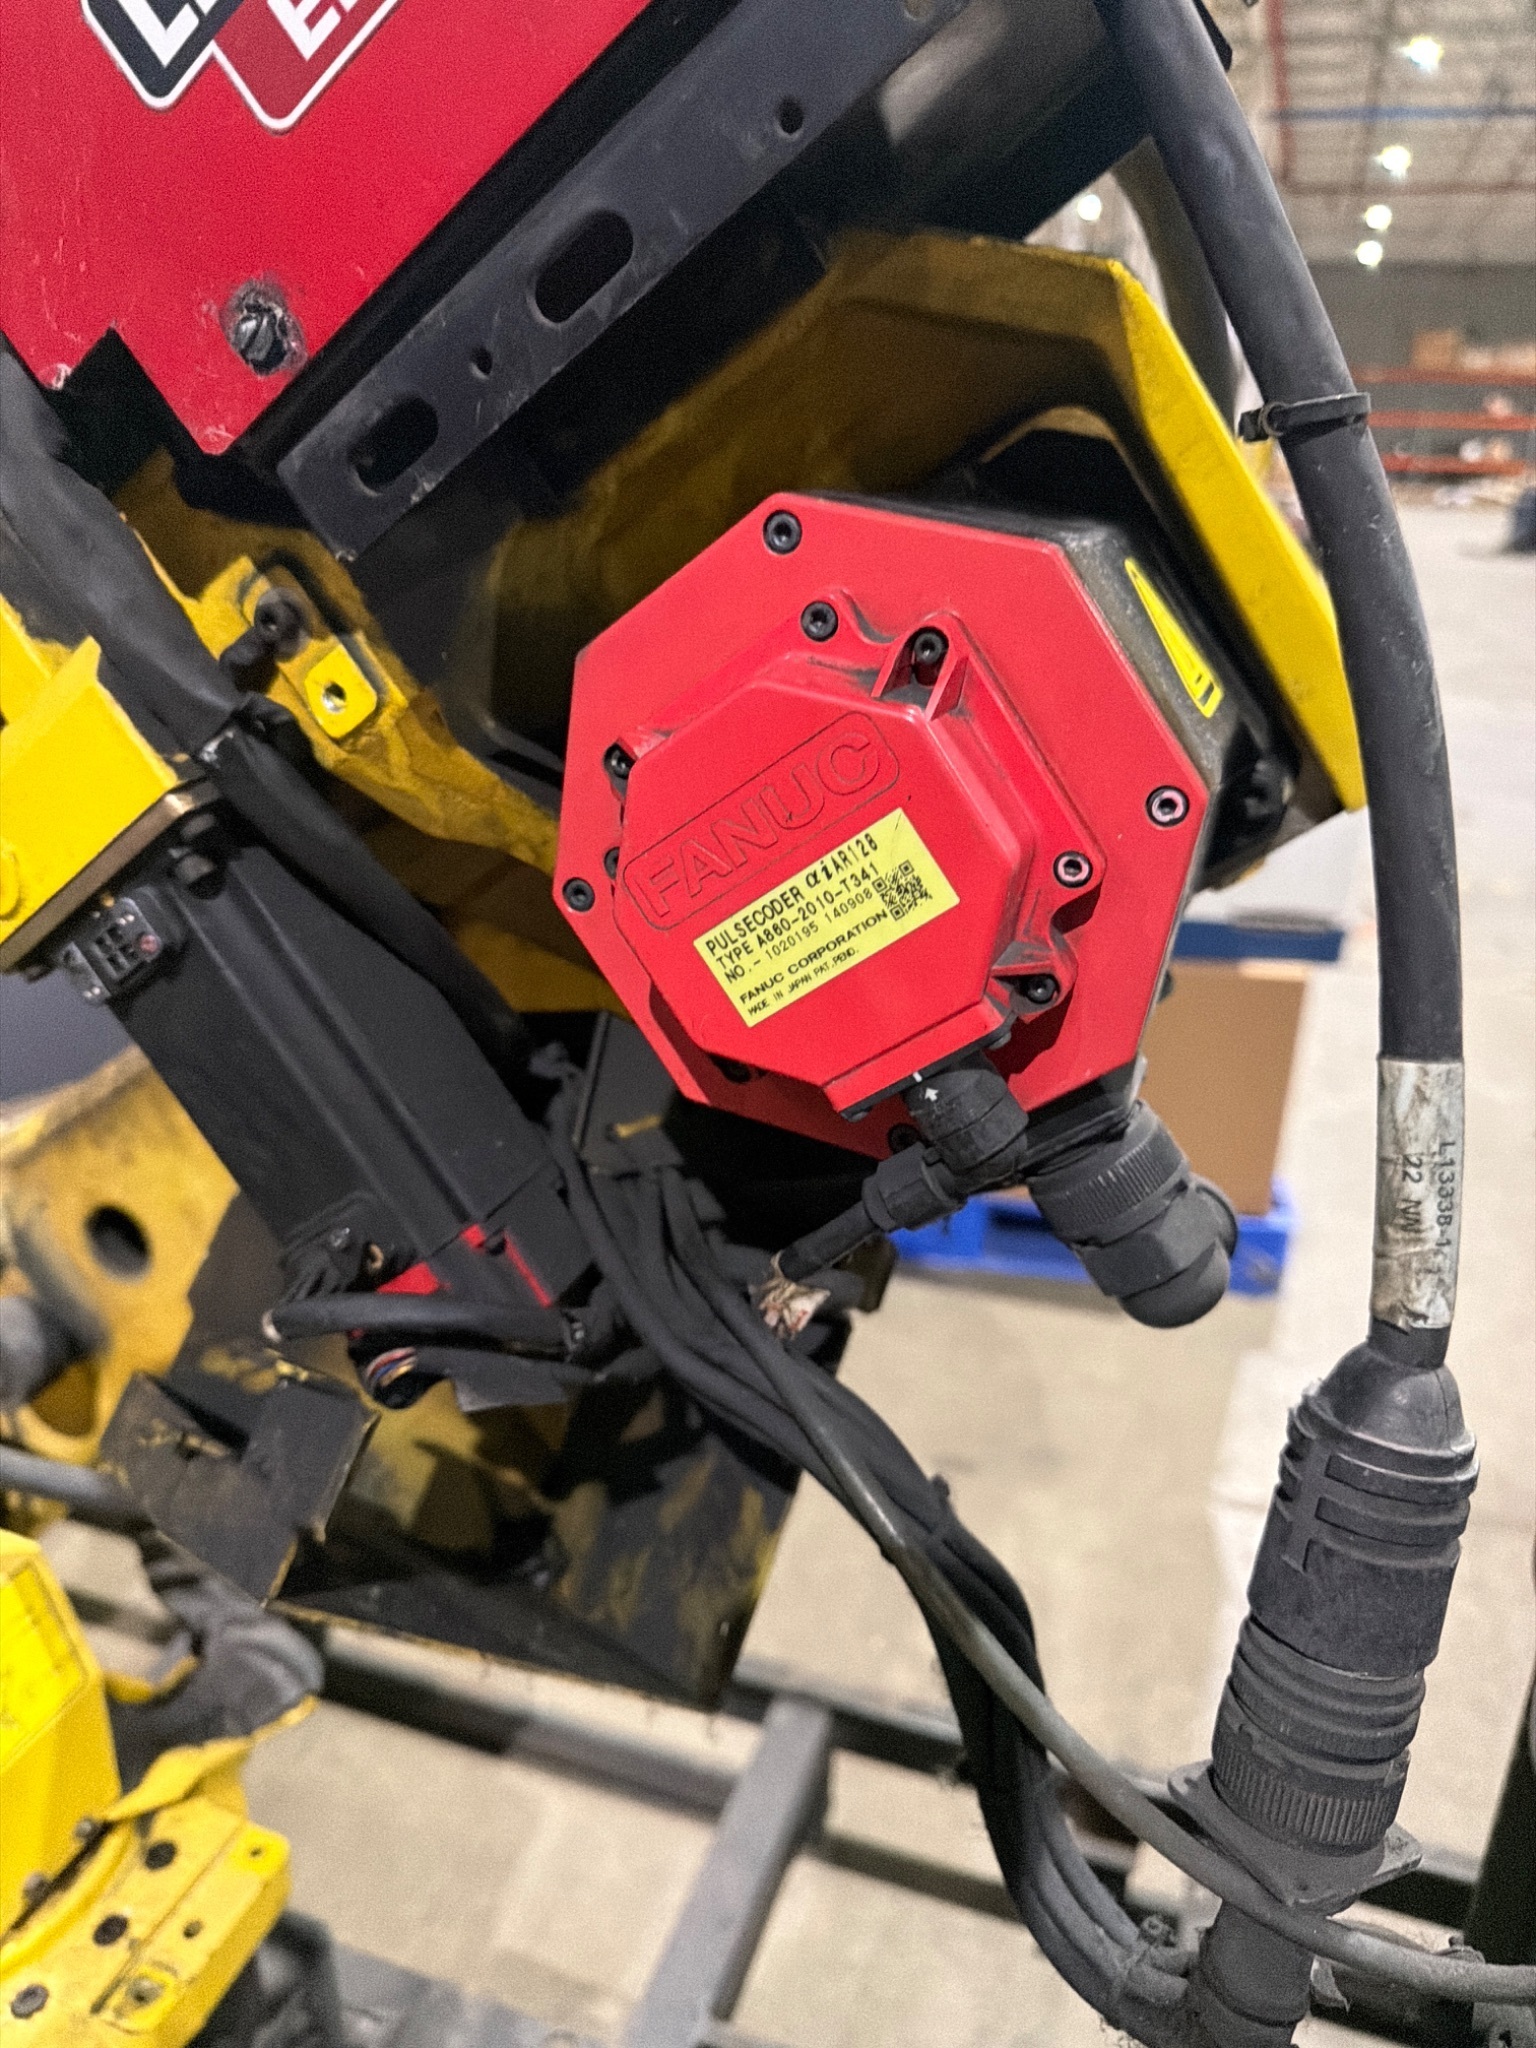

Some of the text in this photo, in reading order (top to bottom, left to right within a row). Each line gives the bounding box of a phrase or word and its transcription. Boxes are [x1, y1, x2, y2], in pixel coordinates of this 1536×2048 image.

[634, 731, 880, 918] FANUC
[705, 885, 806, 957] PULSECODER
[715, 861, 879, 970] TYPE A860-2010-T341
[765, 920, 819, 960] 1020195
[824, 887, 873, 924] 140908
[739, 908, 888, 1004] FANUC CORPORATION
[747, 998, 770, 1016] MADE
[772, 989, 784, 1002] IN
[788, 973, 812, 993] JAPAN
[1401, 1153, 1423, 1184] 22
